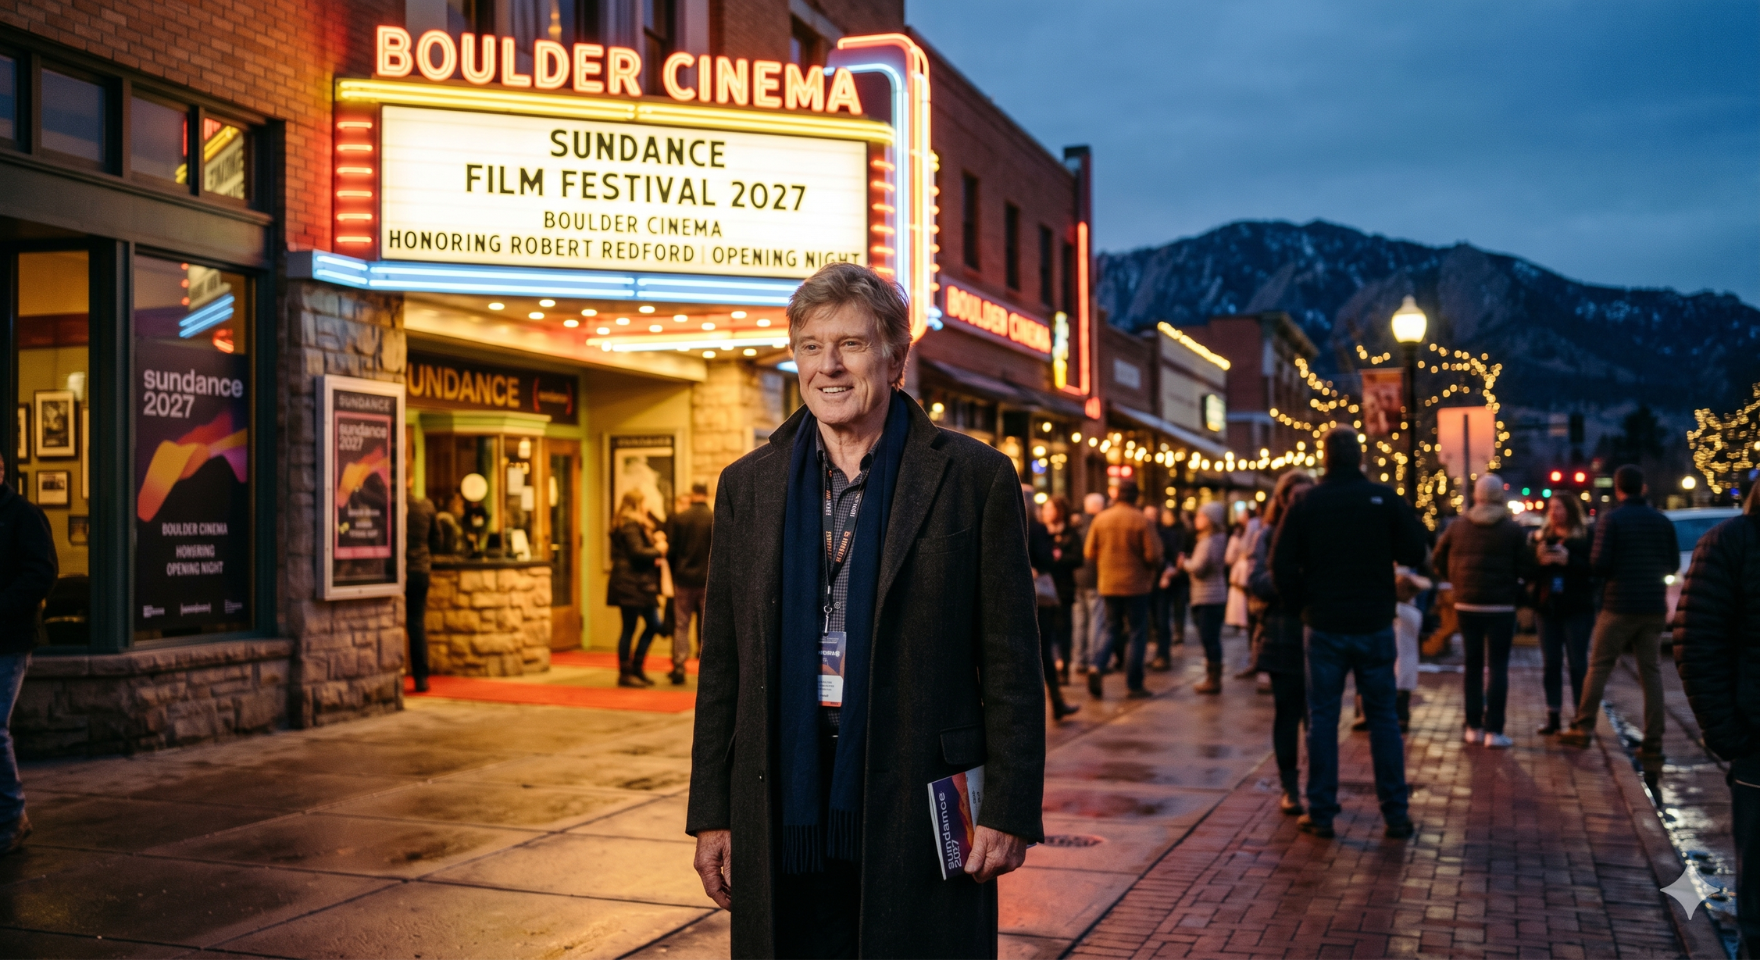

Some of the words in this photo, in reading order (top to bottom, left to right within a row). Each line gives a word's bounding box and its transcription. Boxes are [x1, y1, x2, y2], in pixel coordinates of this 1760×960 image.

[376, 25, 642, 97] BOULDER
[662, 51, 863, 115] CINEMA
[550, 129, 726, 169] SUNDANCE
[466, 164, 544, 196] FILM
[562, 170, 716, 206] FESTIVAL
[731, 181, 806, 211] 2027
[544, 211, 638, 234] BOULDER
[647, 216, 723, 238] CINEMA
[389, 230, 501, 253] HONORING
[511, 236, 593, 258] ROBERT
[602, 241, 694, 263] REDFORD
[712, 246, 797, 268] OPENING
[805, 251, 861, 269] NIGHT
[947, 285, 1008, 337] BOULDER
[1008, 312, 1051, 354] CINEMA
[143, 368, 243, 398] sundance
[407, 362, 521, 409] UNDANCE
[143, 391, 195, 419] 2027
[339, 422, 388, 439] sundance
[339, 435, 364, 451] 2027
[162, 522, 198, 536] BOULDER
[199, 522, 228, 535] CINEMA
[166, 562, 200, 576] OPENING
[201, 561, 224, 575] NIGHT
